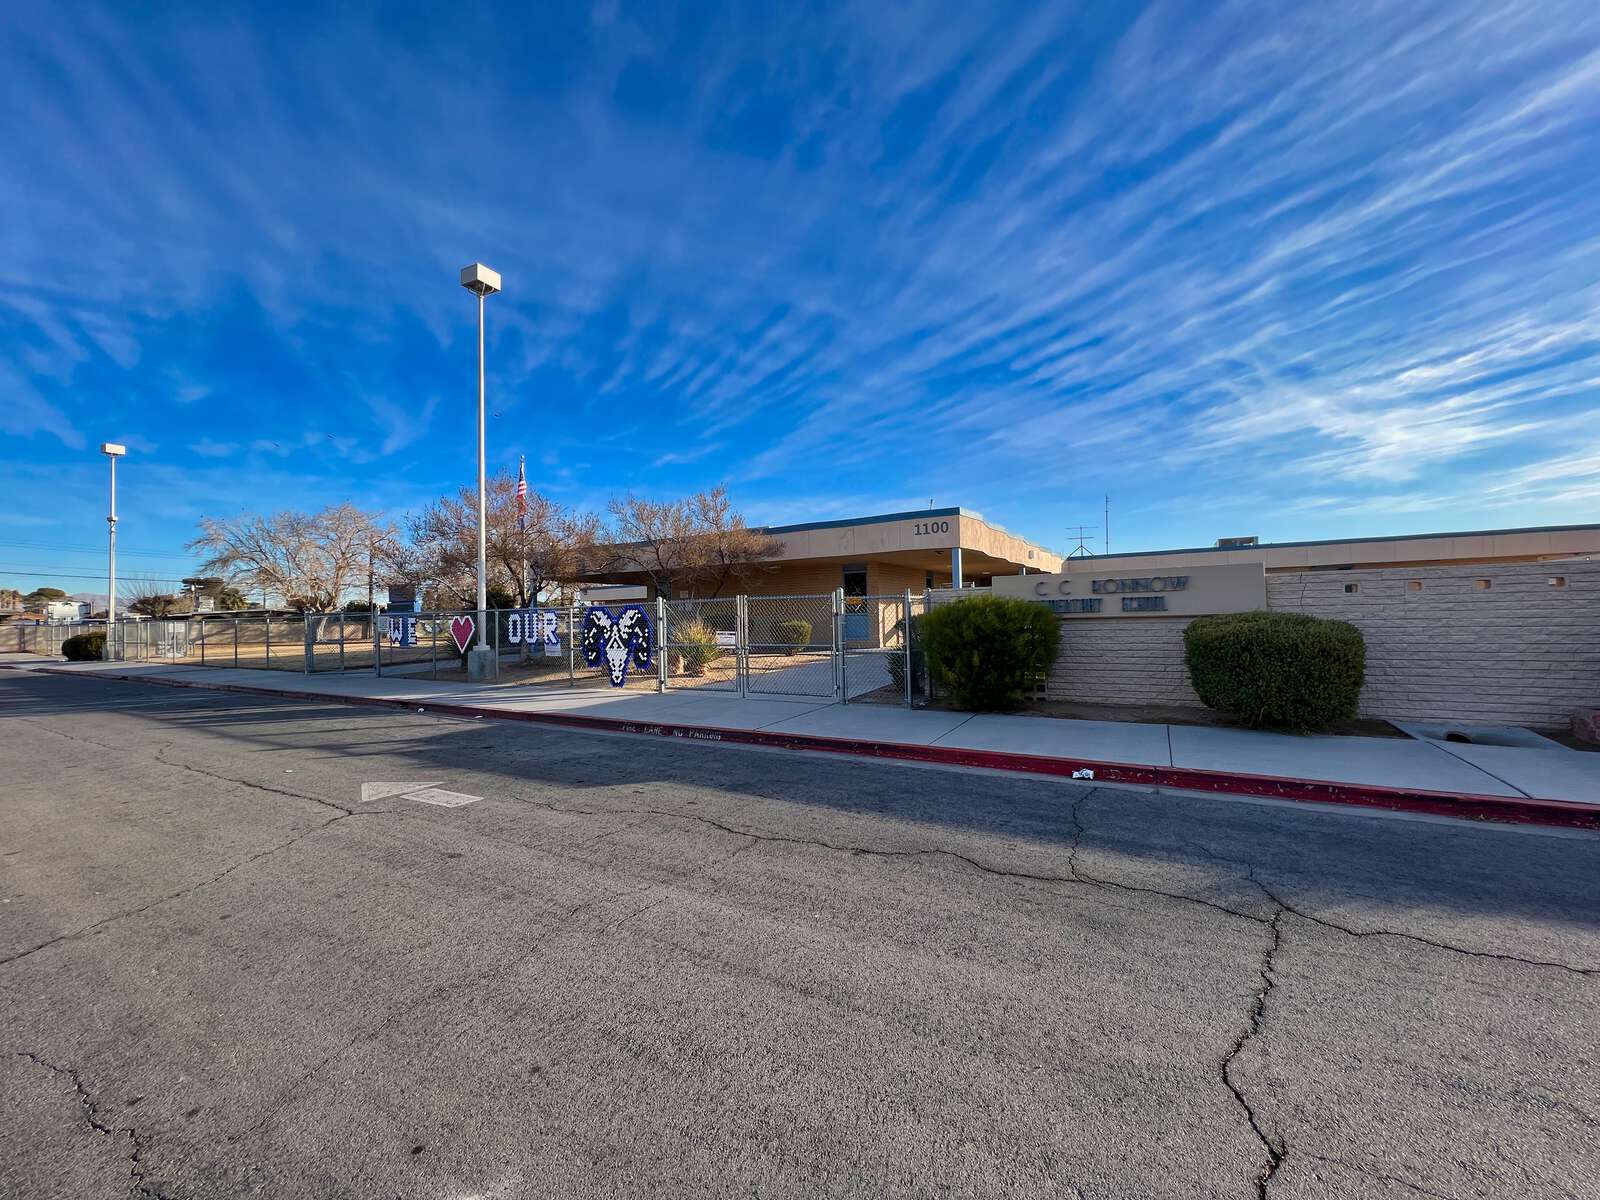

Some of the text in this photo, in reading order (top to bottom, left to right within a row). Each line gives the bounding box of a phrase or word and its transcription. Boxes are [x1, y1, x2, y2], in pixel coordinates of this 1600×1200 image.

[914, 521, 949, 536] 1100
[1034, 581, 1049, 596] C
[1058, 580, 1073, 596] C
[389, 616, 417, 643] WE
[508, 612, 559, 644] OUR
[672, 728, 684, 737] NO
